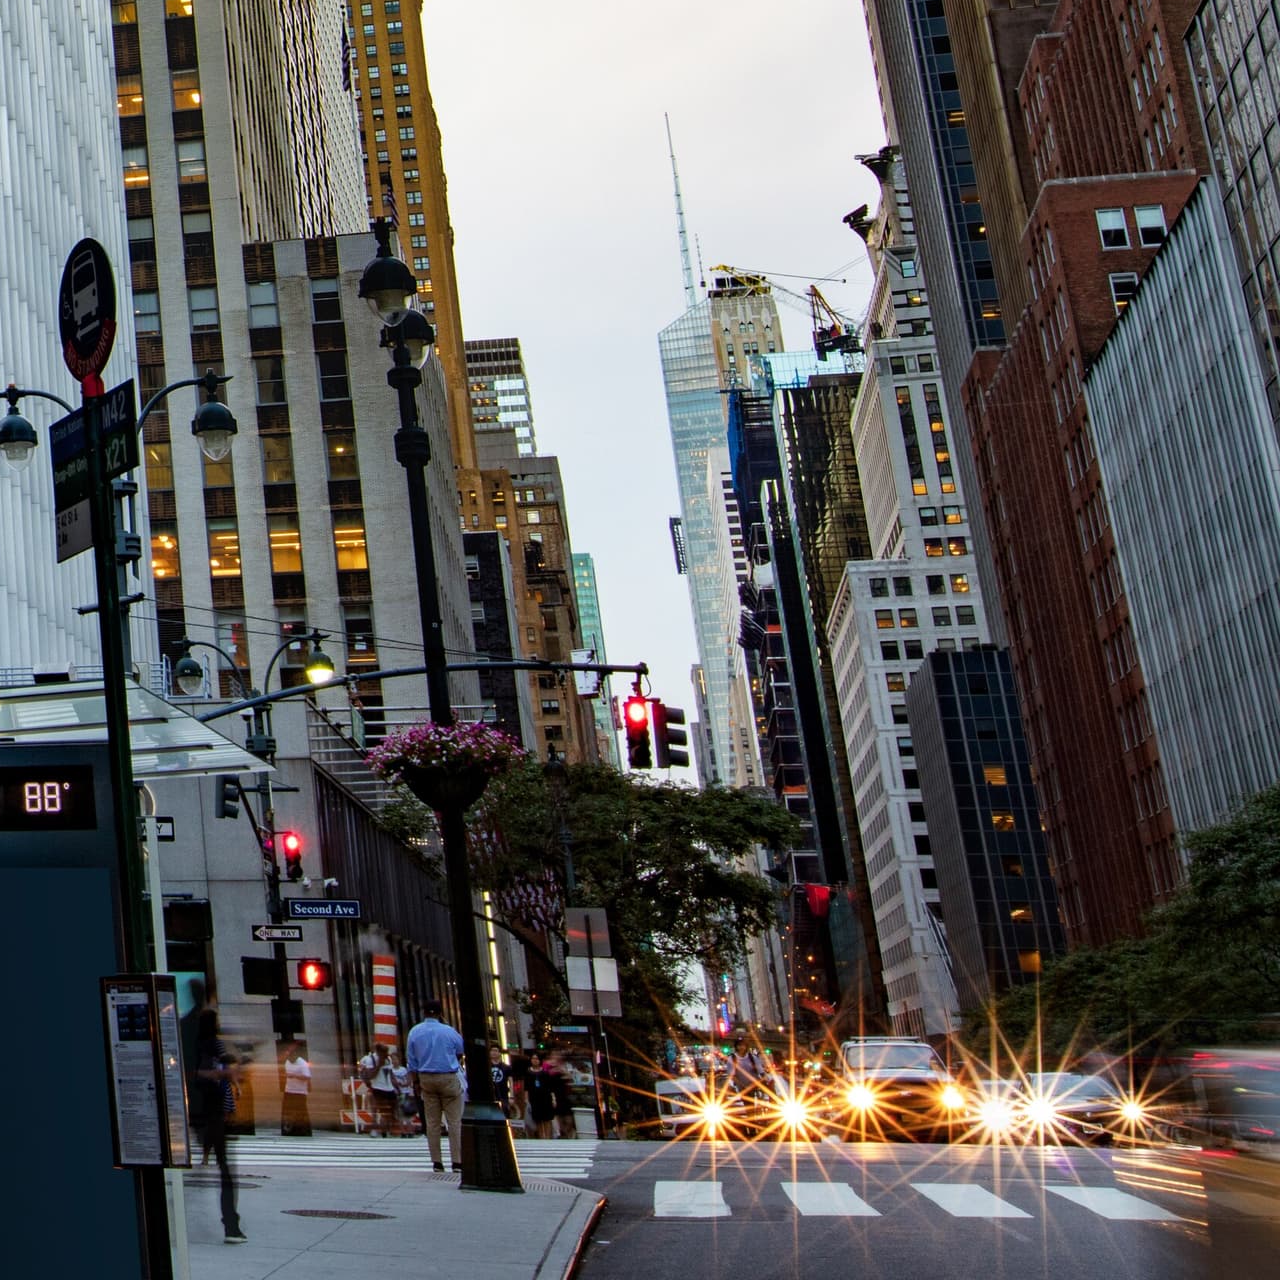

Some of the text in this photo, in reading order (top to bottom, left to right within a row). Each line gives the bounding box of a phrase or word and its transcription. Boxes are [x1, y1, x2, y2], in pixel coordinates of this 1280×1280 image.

[102, 390, 127, 428] M42
[105, 434, 128, 472] X21
[294, 903, 355, 915] Second Ave
[259, 929, 274, 937] ONE
